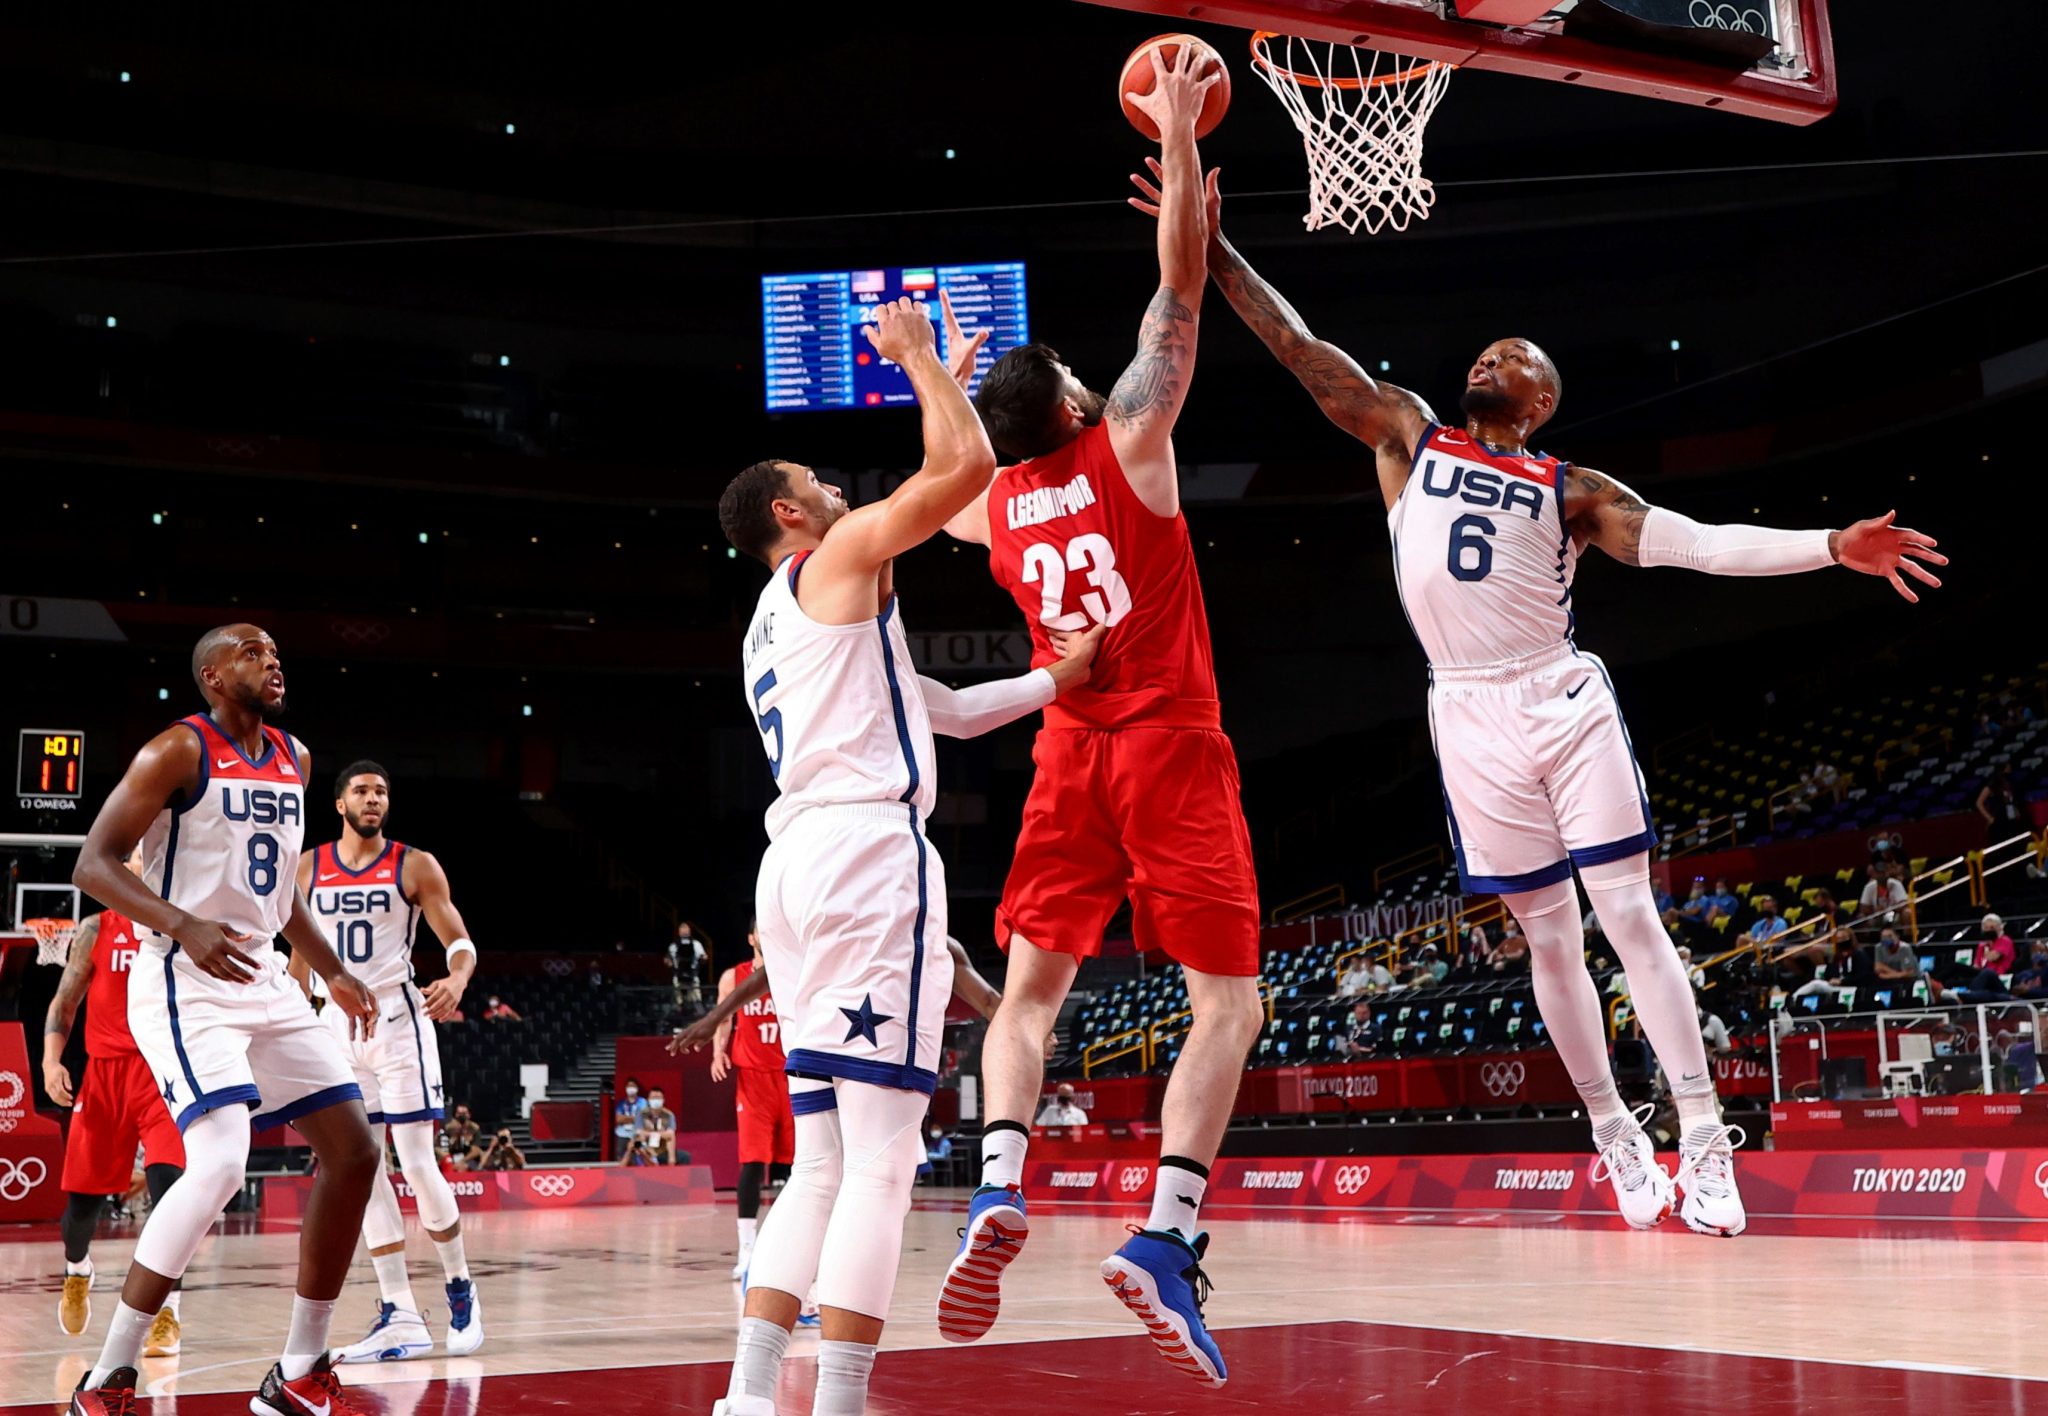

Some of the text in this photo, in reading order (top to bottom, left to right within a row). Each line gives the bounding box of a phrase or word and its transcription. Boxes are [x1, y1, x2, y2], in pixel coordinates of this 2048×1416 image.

[1422, 459, 1544, 521] USA
[1446, 512, 1497, 582] 6
[1022, 532, 1133, 632] 23
[753, 667, 784, 780] 5
[44, 736, 80, 756] 1:01
[41, 760, 76, 791] 11
[33, 798, 76, 810] OMEGA
[222, 787, 300, 826] USA
[247, 832, 279, 896] 8
[316, 890, 391, 915] USA
[1343, 902, 1408, 941] TOKYO
[336, 920, 373, 963] 10
[111, 949, 138, 972] IR
[743, 998, 777, 1016] IRA
[757, 1022, 779, 1044] 17
[1303, 1075, 1378, 1098] TOKYO 2020
[1050, 1171, 1098, 1187] TOKYO 2020
[1242, 1171, 1304, 1188] TOKYO 2020
[1494, 1169, 1574, 1190] TOKYO 2020
[1853, 1168, 1967, 1192] TOKYO 2020
